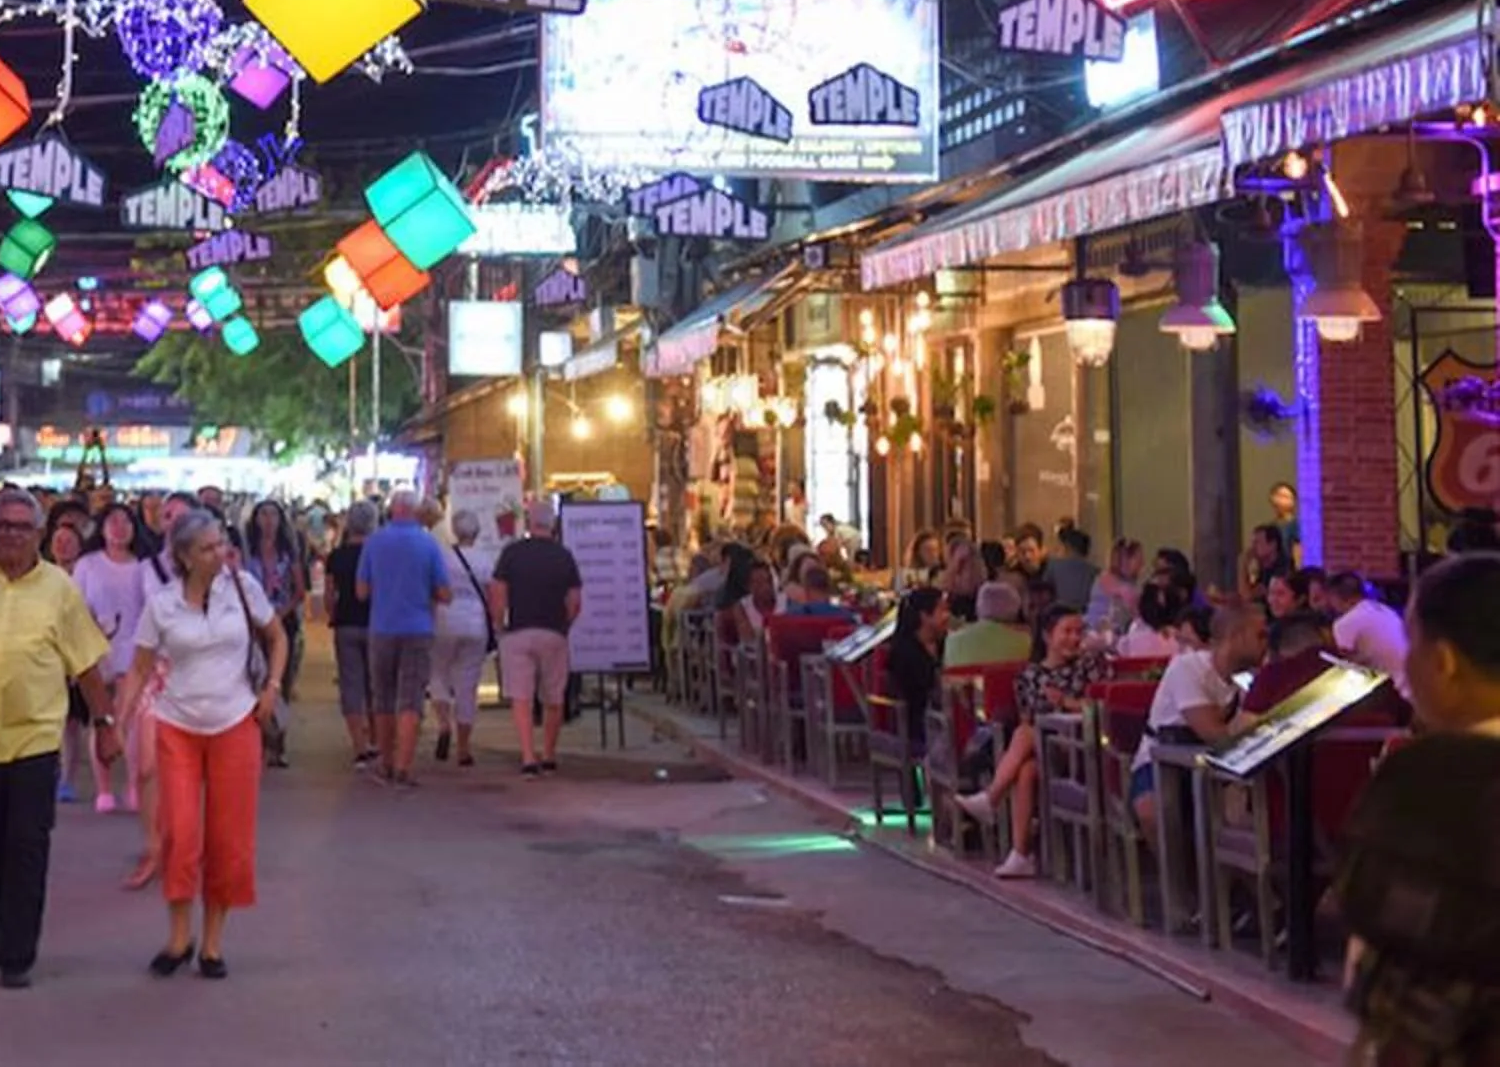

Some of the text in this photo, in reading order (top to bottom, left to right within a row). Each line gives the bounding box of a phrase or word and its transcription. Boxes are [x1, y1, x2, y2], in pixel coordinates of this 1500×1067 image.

[702, 79, 790, 139] TEMPLE
[812, 65, 916, 123] TEMPLE
[657, 191, 767, 236] TEMPLE
